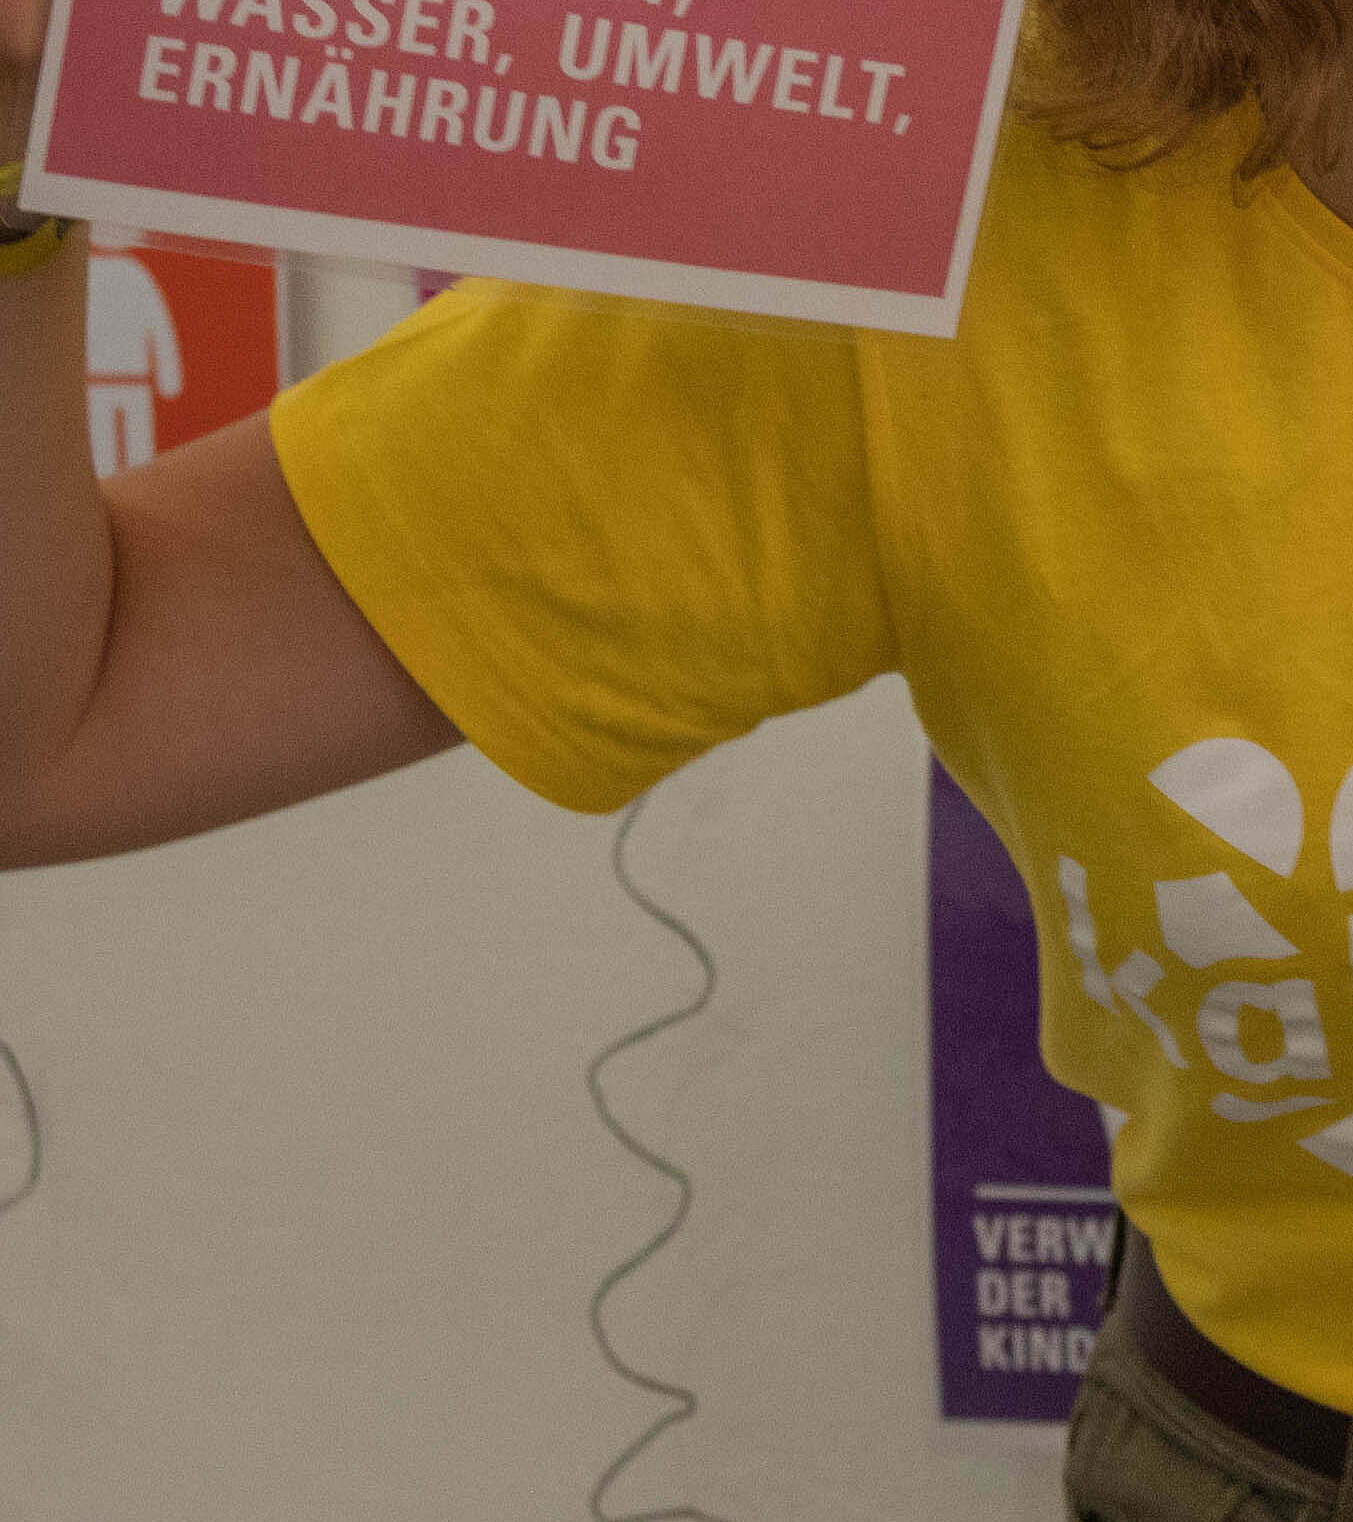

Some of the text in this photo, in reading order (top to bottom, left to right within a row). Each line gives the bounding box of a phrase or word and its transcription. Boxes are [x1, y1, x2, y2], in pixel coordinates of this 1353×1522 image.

[138, 35, 643, 171] ERNÄHRUNG
[557, 13, 913, 134] UMWELT,
[977, 1269, 1072, 1320] DER
[979, 1325, 1096, 1376] KIND
